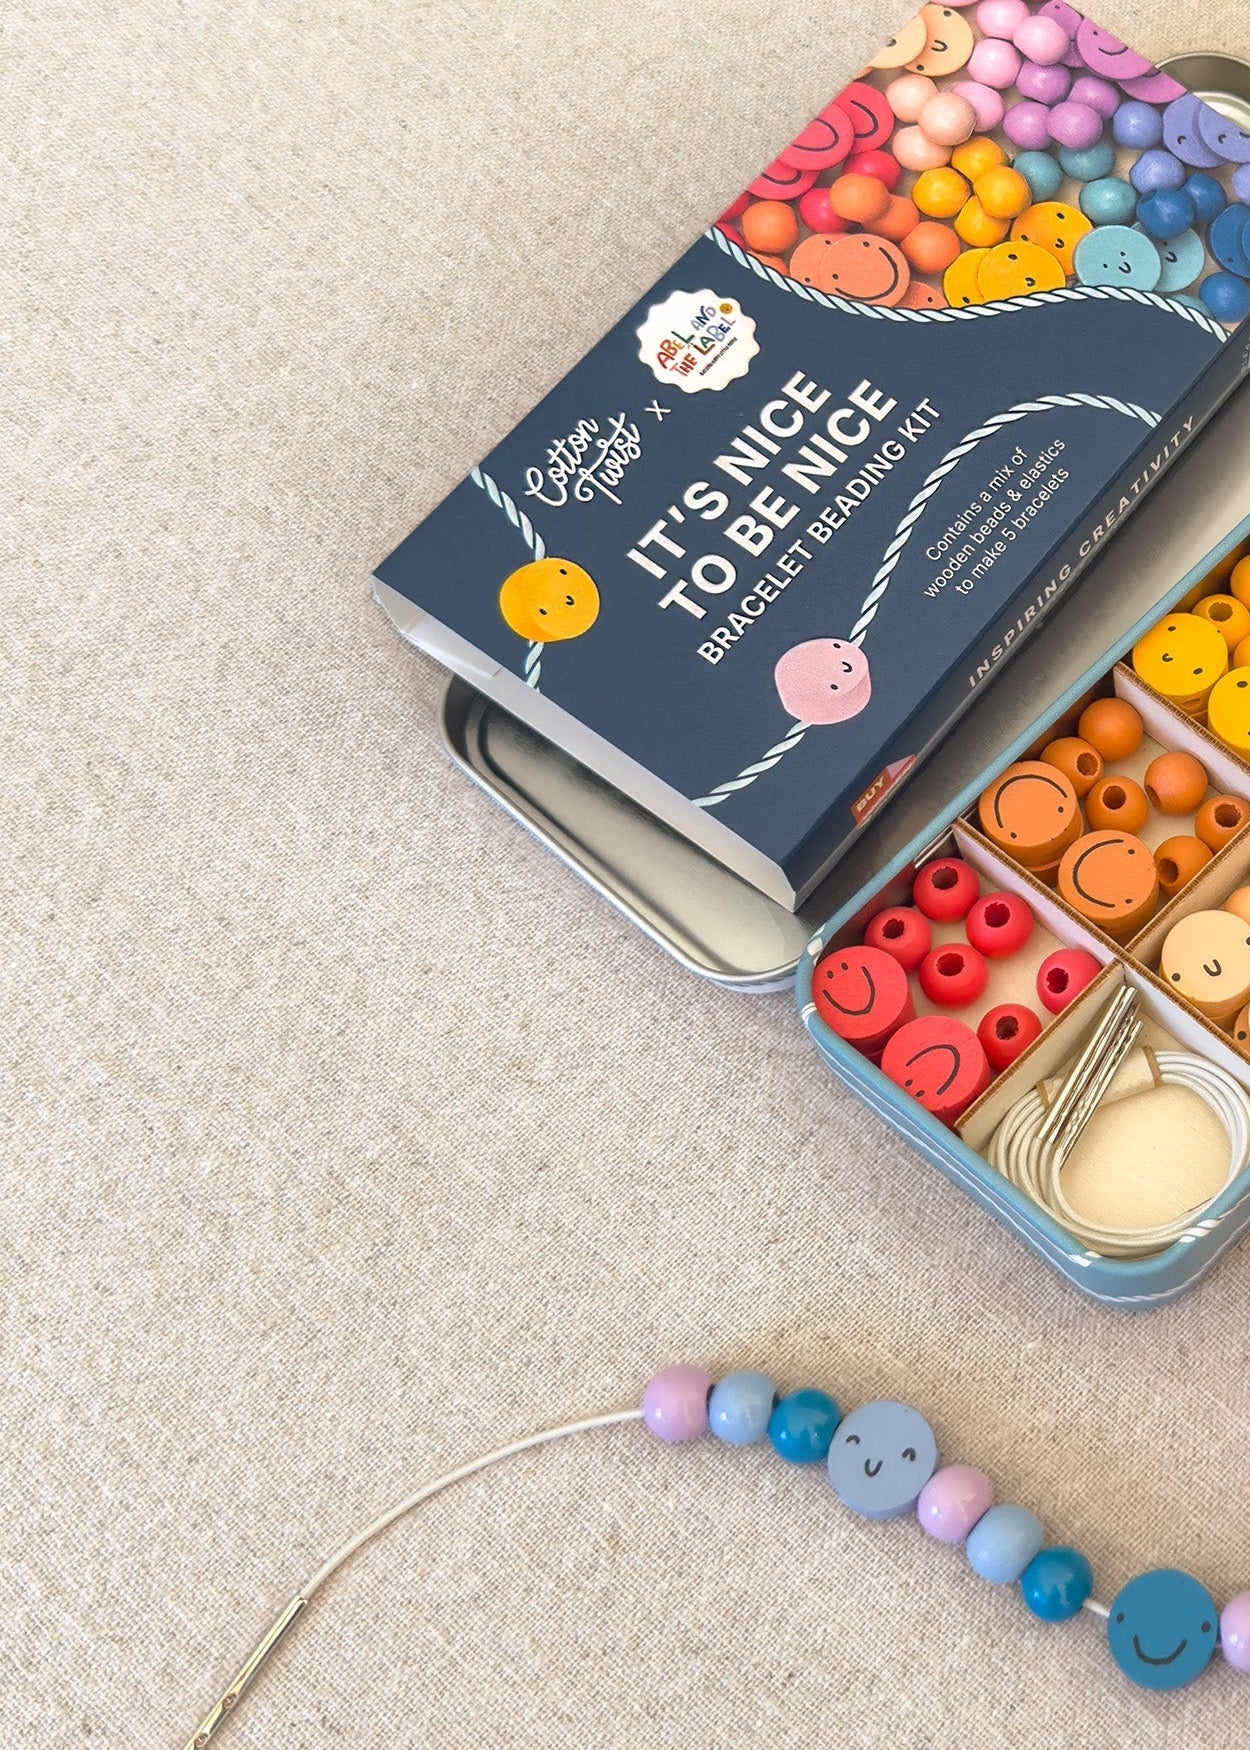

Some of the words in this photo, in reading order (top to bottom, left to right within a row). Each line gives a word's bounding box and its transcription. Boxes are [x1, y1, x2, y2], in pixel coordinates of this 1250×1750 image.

[656, 331, 695, 369] ABEL
[690, 305, 717, 331] AND
[669, 353, 698, 377] THE
[690, 317, 736, 356] LABEL
[524, 418, 599, 507] Cotton
[575, 412, 641, 505] Twist
[626, 481, 729, 580] IT'S
[713, 370, 832, 486] NICE
[658, 553, 737, 620] TO
[723, 485, 801, 557] BE
[781, 379, 898, 495] NICE
[924, 544, 976, 598] wooden
[969, 501, 1012, 544] beads
[1006, 488, 1023, 502] &
[1020, 439, 1066, 490] elastics
[926, 502, 982, 561] Contains
[980, 491, 992, 503] a
[988, 465, 1015, 491] mix
[1011, 446, 1028, 466] of
[696, 539, 814, 665] BRACELET
[806, 440, 906, 545] BEADING
[898, 397, 941, 443] KIT
[955, 579, 974, 595] to
[971, 541, 1007, 579] make
[1001, 527, 1017, 541] 5
[1011, 468, 1070, 530] bracelets
[968, 563, 1073, 687] INSPIRING
[1078, 415, 1194, 558] CREATIVITY
[856, 776, 885, 813] BUY
